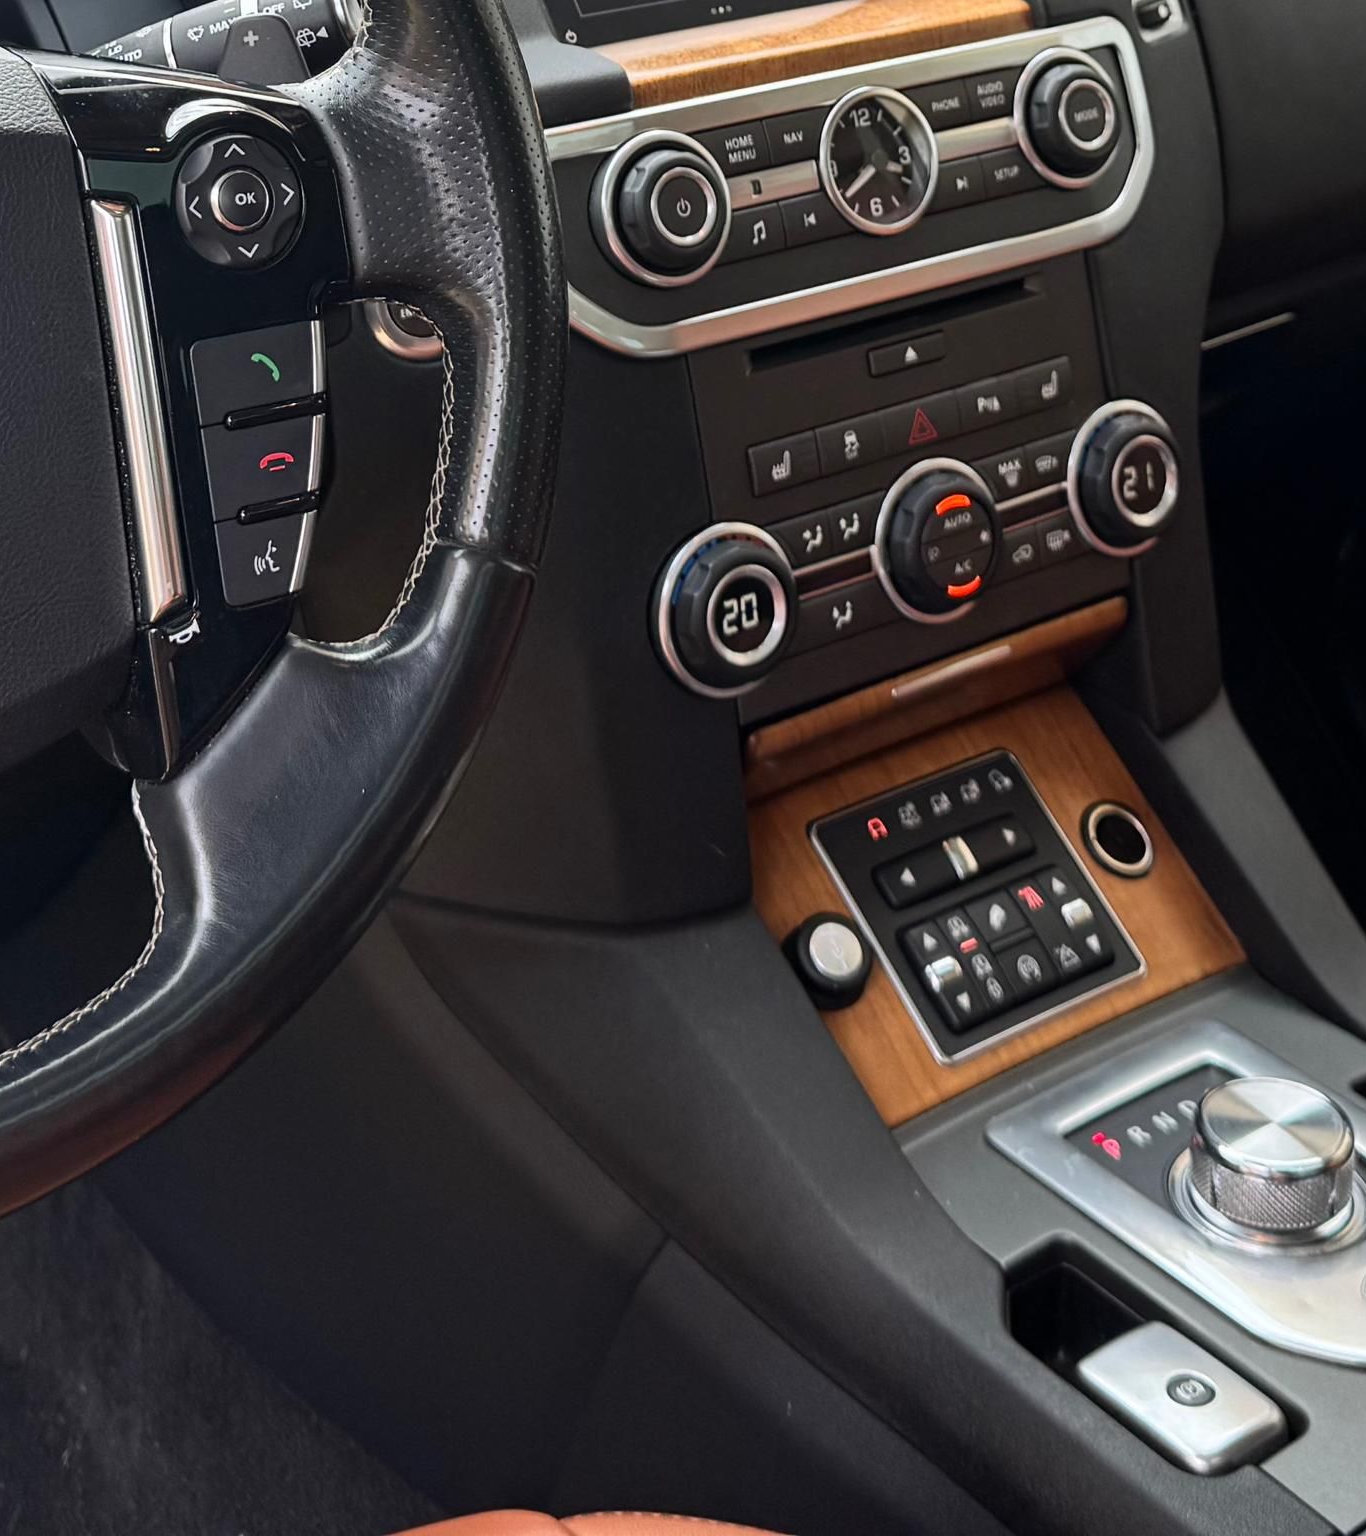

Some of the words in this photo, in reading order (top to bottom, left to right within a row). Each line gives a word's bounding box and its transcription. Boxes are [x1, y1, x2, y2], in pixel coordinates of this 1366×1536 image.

[262, 3, 285, 16] OFF
[977, 80, 1004, 96] AUDIO
[931, 96, 961, 112] PHONE
[980, 94, 1006, 109] VIDEO
[849, 107, 871, 128] 12
[1074, 107, 1098, 123] MODE
[725, 134, 754, 151] HOME
[784, 130, 804, 144] NAV
[728, 149, 756, 163] MENU
[898, 146, 912, 164] 3
[994, 165, 1020, 180] SETUP
[234, 190, 257, 207] OK
[870, 197, 884, 217] 6
[998, 459, 1022, 474] MAX
[1123, 461, 1153, 500] 21
[944, 511, 972, 529] AUTO
[722, 592, 759, 636] 20
[1102, 1138, 1121, 1161] P
[1126, 1125, 1152, 1147] R
[1151, 1110, 1178, 1135] N
